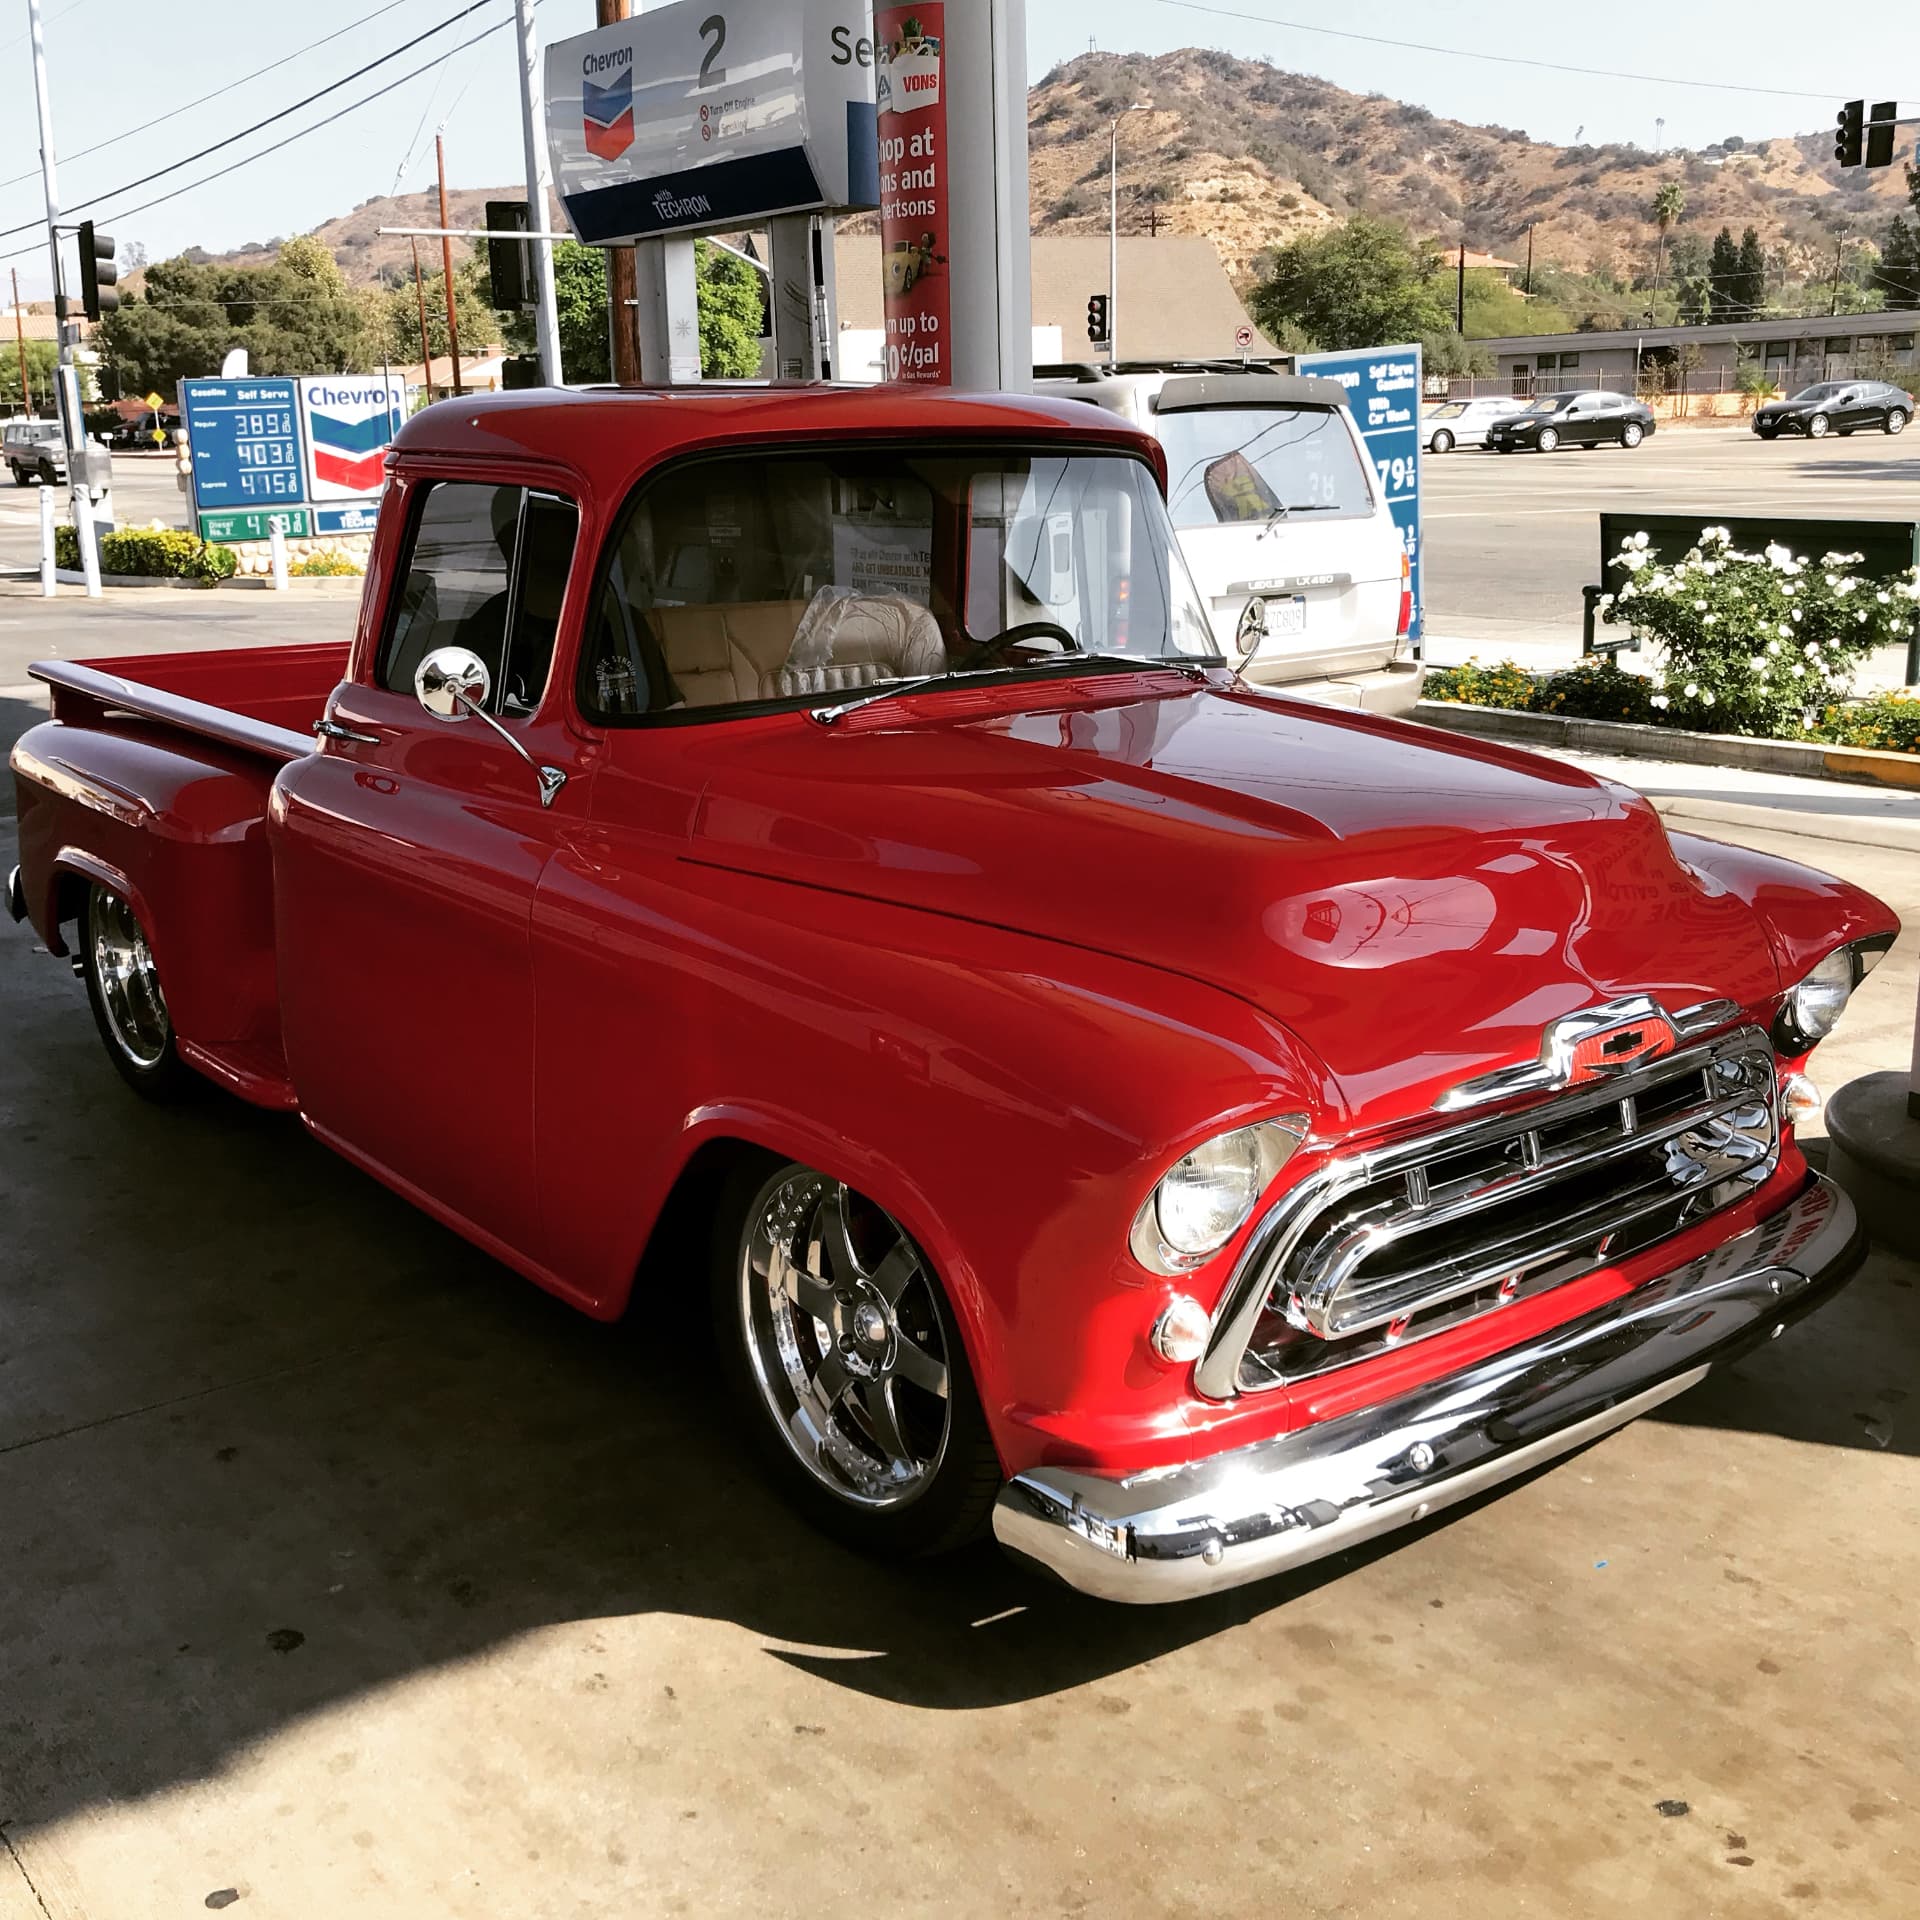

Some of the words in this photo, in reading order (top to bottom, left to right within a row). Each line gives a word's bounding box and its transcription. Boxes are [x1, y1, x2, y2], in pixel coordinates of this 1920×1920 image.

[583, 46, 632, 75] Chevron
[698, 14, 726, 89] 2
[903, 74, 937, 93] VONS
[710, 105, 724, 115] Turn
[724, 100, 734, 111] Off
[735, 97, 756, 109] Engine
[879, 135, 904, 167] hop
[910, 126, 935, 157] at
[881, 172, 898, 194] ons
[902, 163, 935, 190] and
[652, 195, 711, 220] TECHRON
[900, 316, 916, 338] up
[920, 312, 939, 333] to
[191, 388, 227, 397] Gasoline
[237, 389, 257, 400] Self
[260, 389, 290, 400] Serve
[308, 386, 400, 406] Chevron
[235, 413, 279, 435] 389
[238, 443, 282, 465] 403
[1377, 457, 1405, 496] 79
[340, 516, 377, 528] TECHR
